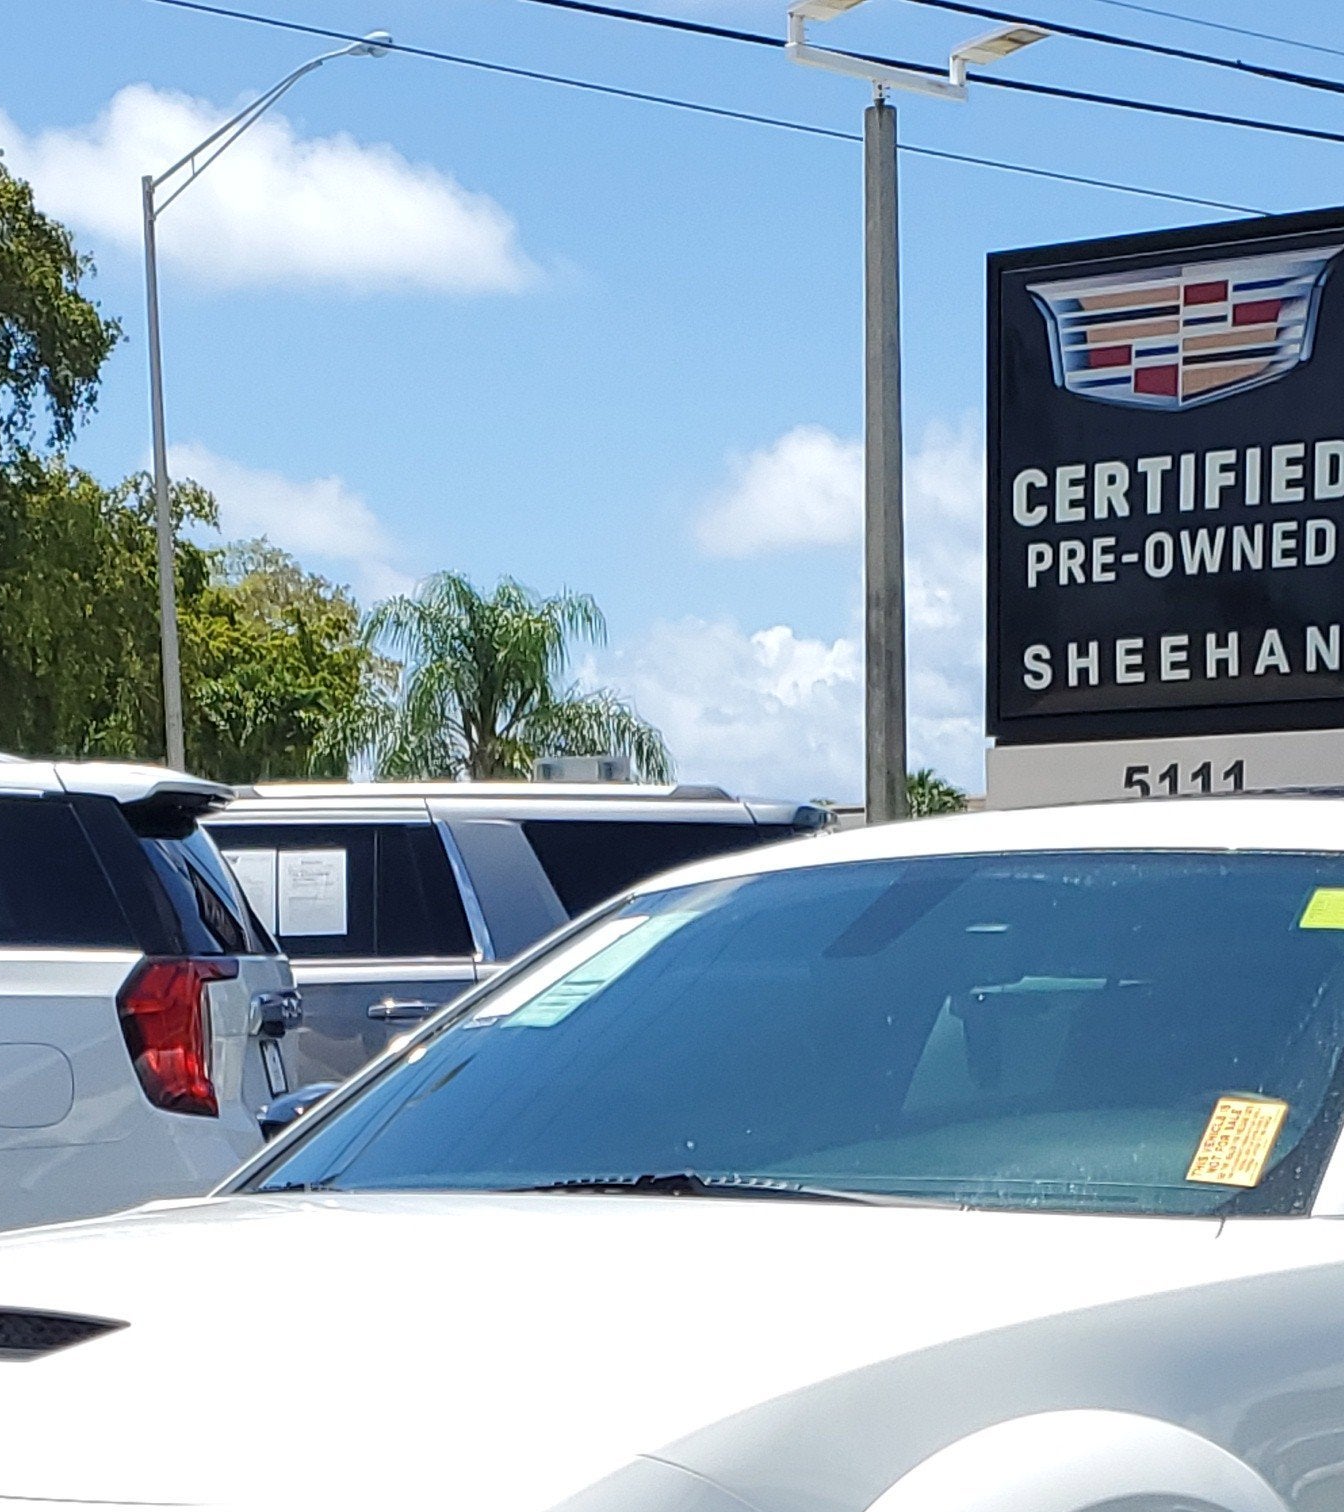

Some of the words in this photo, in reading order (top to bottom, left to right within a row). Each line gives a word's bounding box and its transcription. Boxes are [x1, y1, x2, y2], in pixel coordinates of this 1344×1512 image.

[1027, 518, 1337, 588] PRE-OWNED
[1023, 624, 1342, 691] SHEEHAN
[1124, 759, 1244, 798] 5111
